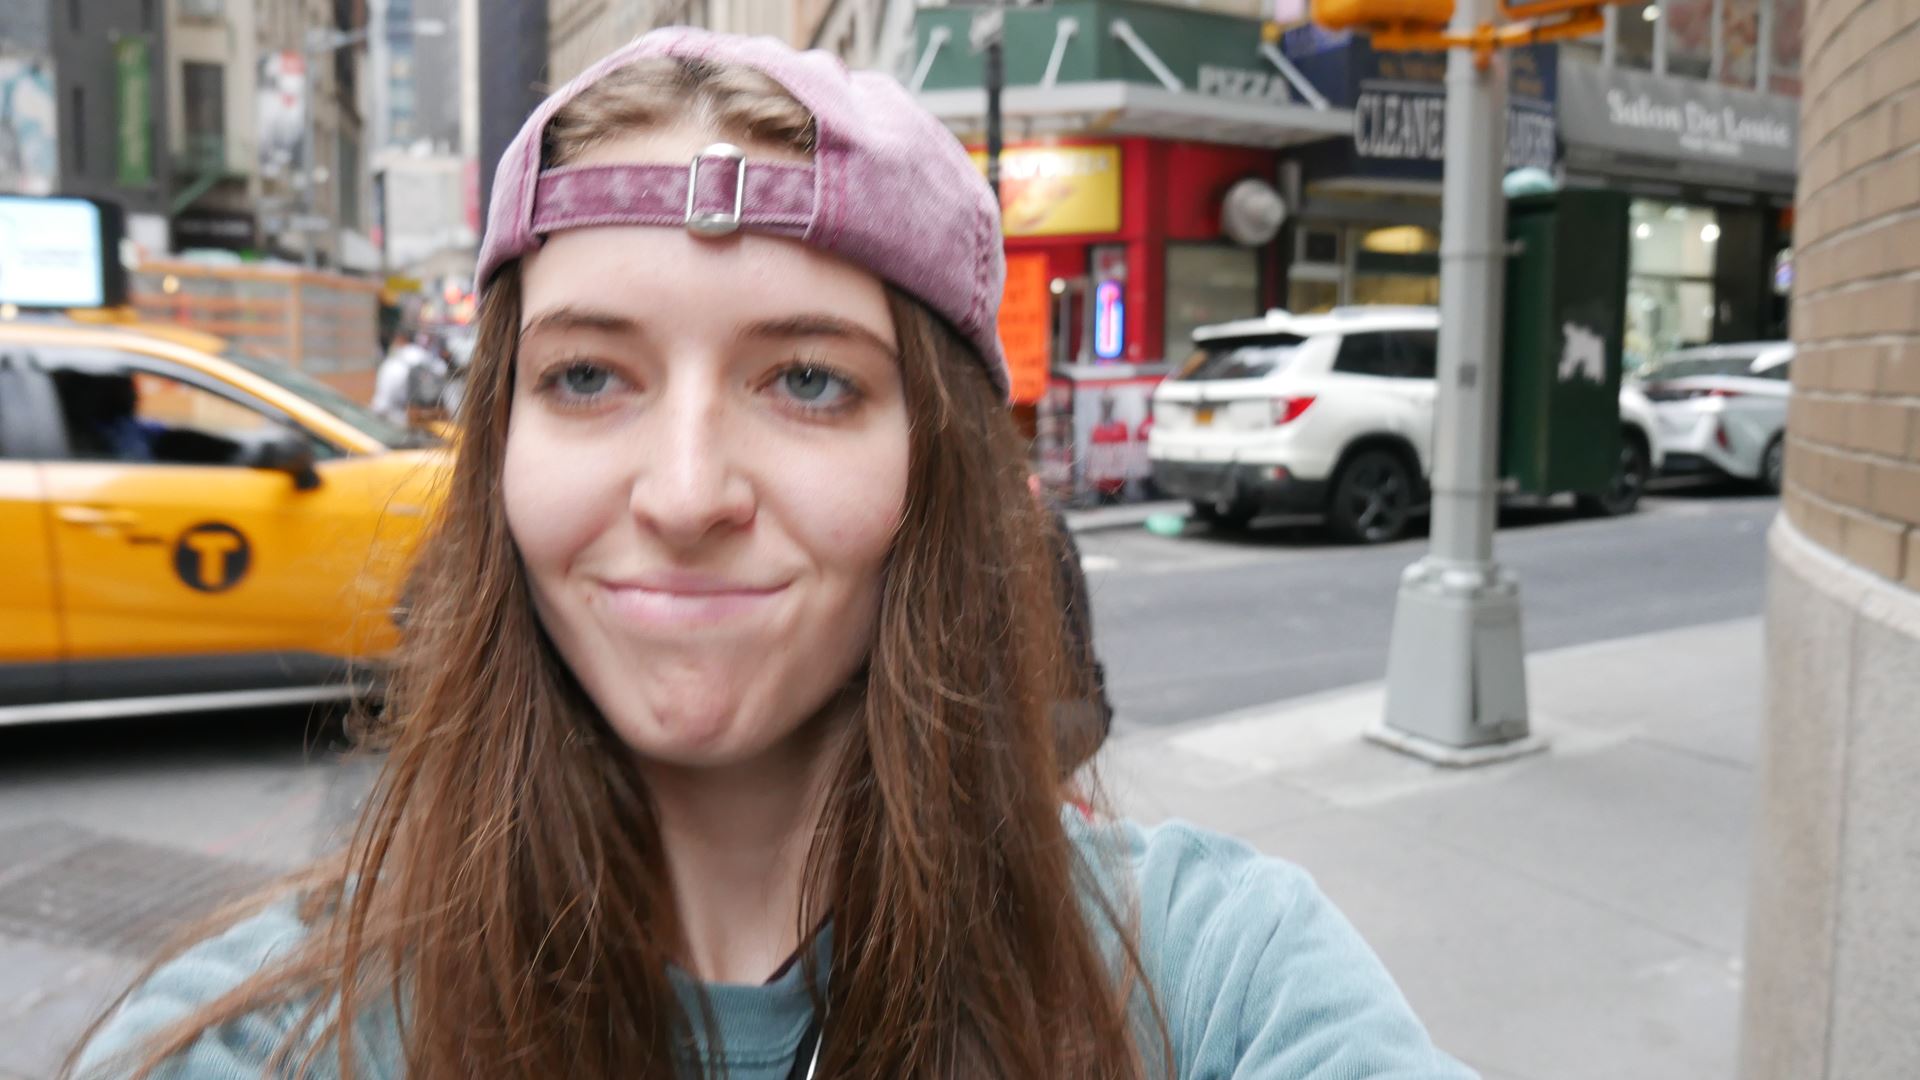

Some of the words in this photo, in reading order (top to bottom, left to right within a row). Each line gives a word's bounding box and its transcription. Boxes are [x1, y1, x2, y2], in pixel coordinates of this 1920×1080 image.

[1197, 66, 1290, 106] PIZZA
[1607, 89, 1682, 131] Salon
[1354, 92, 1447, 160] CLEANE
[188, 532, 238, 586] T
